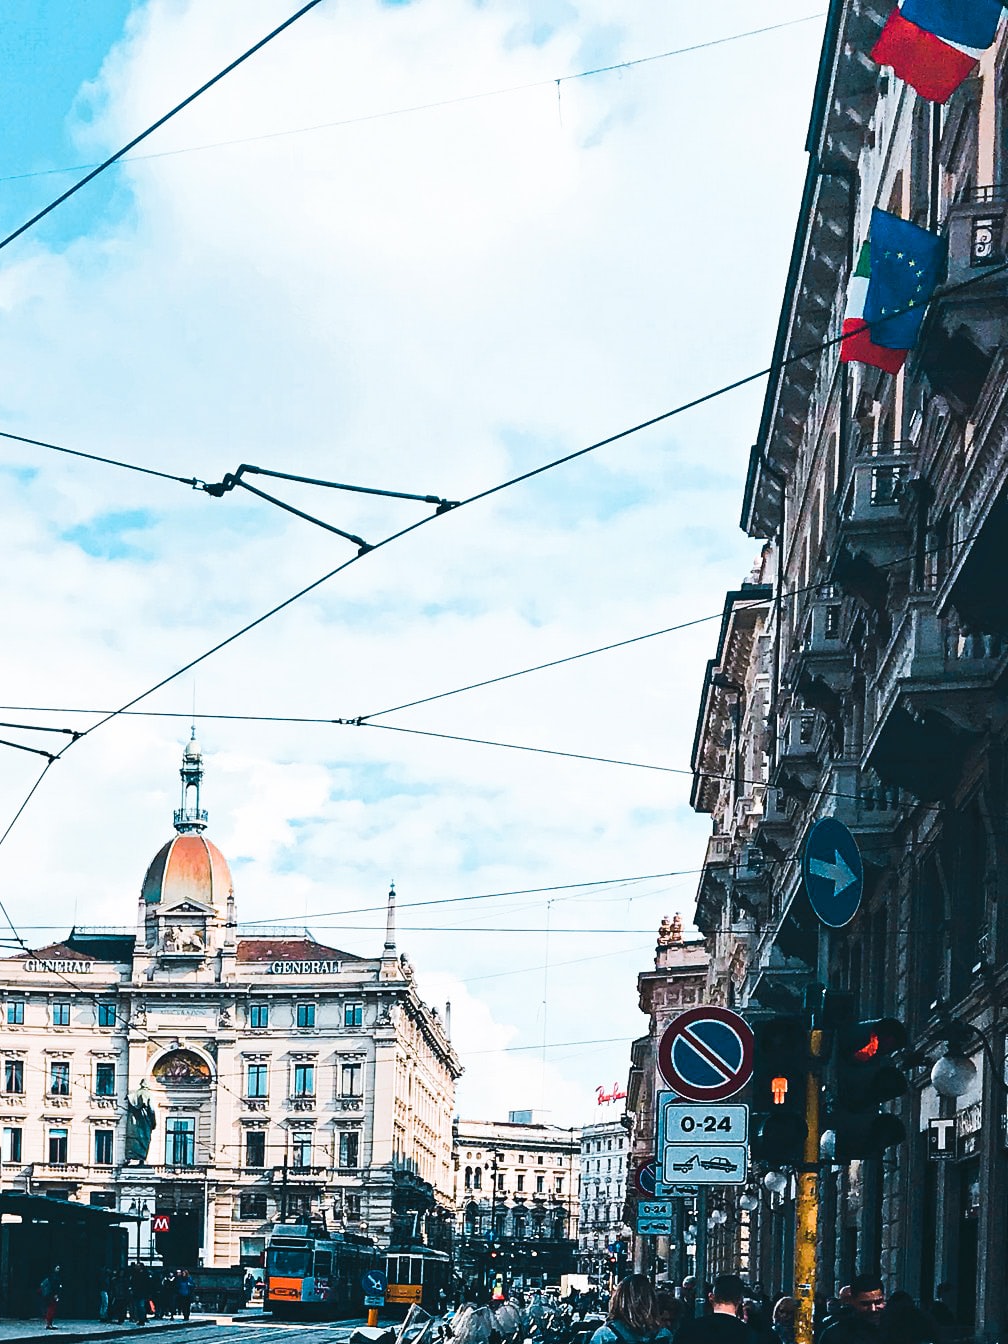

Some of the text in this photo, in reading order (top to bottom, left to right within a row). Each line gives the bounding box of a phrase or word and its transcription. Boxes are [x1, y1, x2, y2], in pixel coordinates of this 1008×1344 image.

[271, 960, 343, 974] GENERALI
[680, 1116, 732, 1133] 0-24
[930, 1120, 954, 1150] T
[643, 1205, 667, 1214] 0-24
[154, 1218, 169, 1230] M
